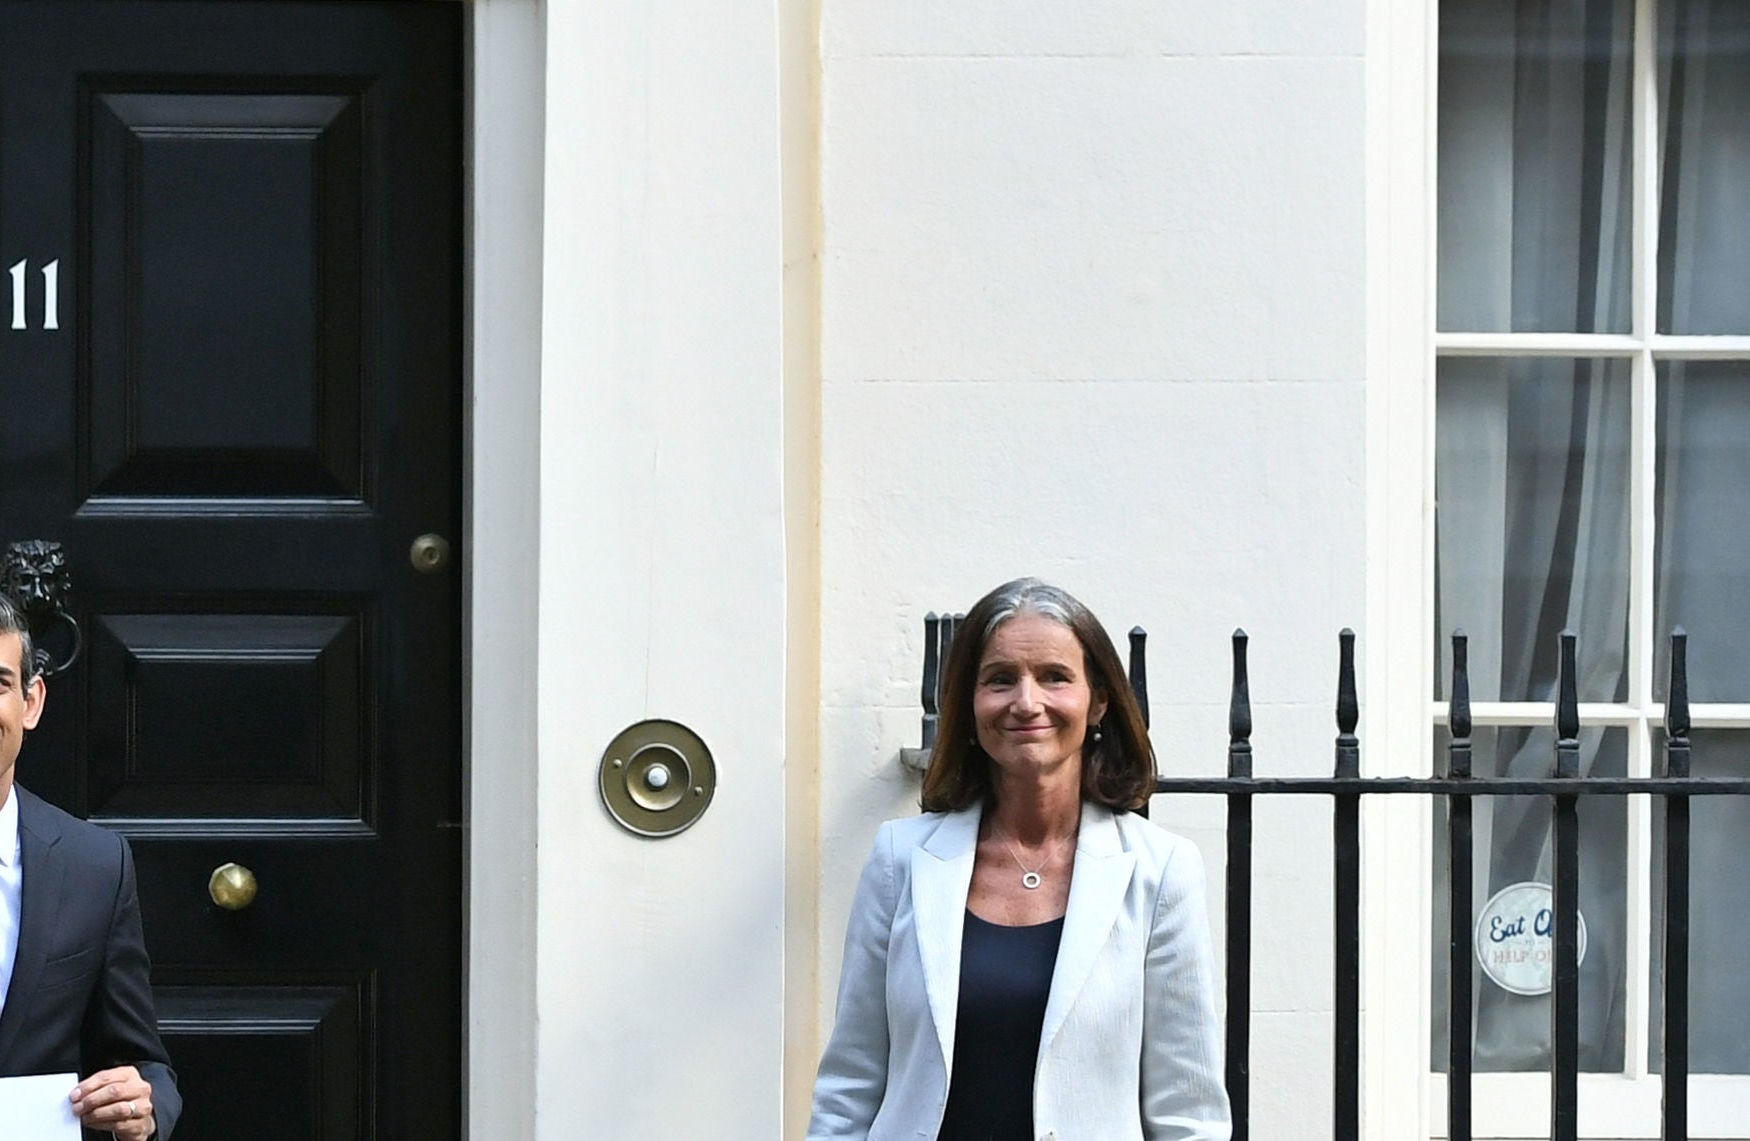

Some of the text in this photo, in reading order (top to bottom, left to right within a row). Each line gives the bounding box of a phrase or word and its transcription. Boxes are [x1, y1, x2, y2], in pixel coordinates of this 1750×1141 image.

[8, 257, 59, 330] 11
[1489, 915, 1526, 943] Eat
[1493, 950, 1529, 963] HELP
